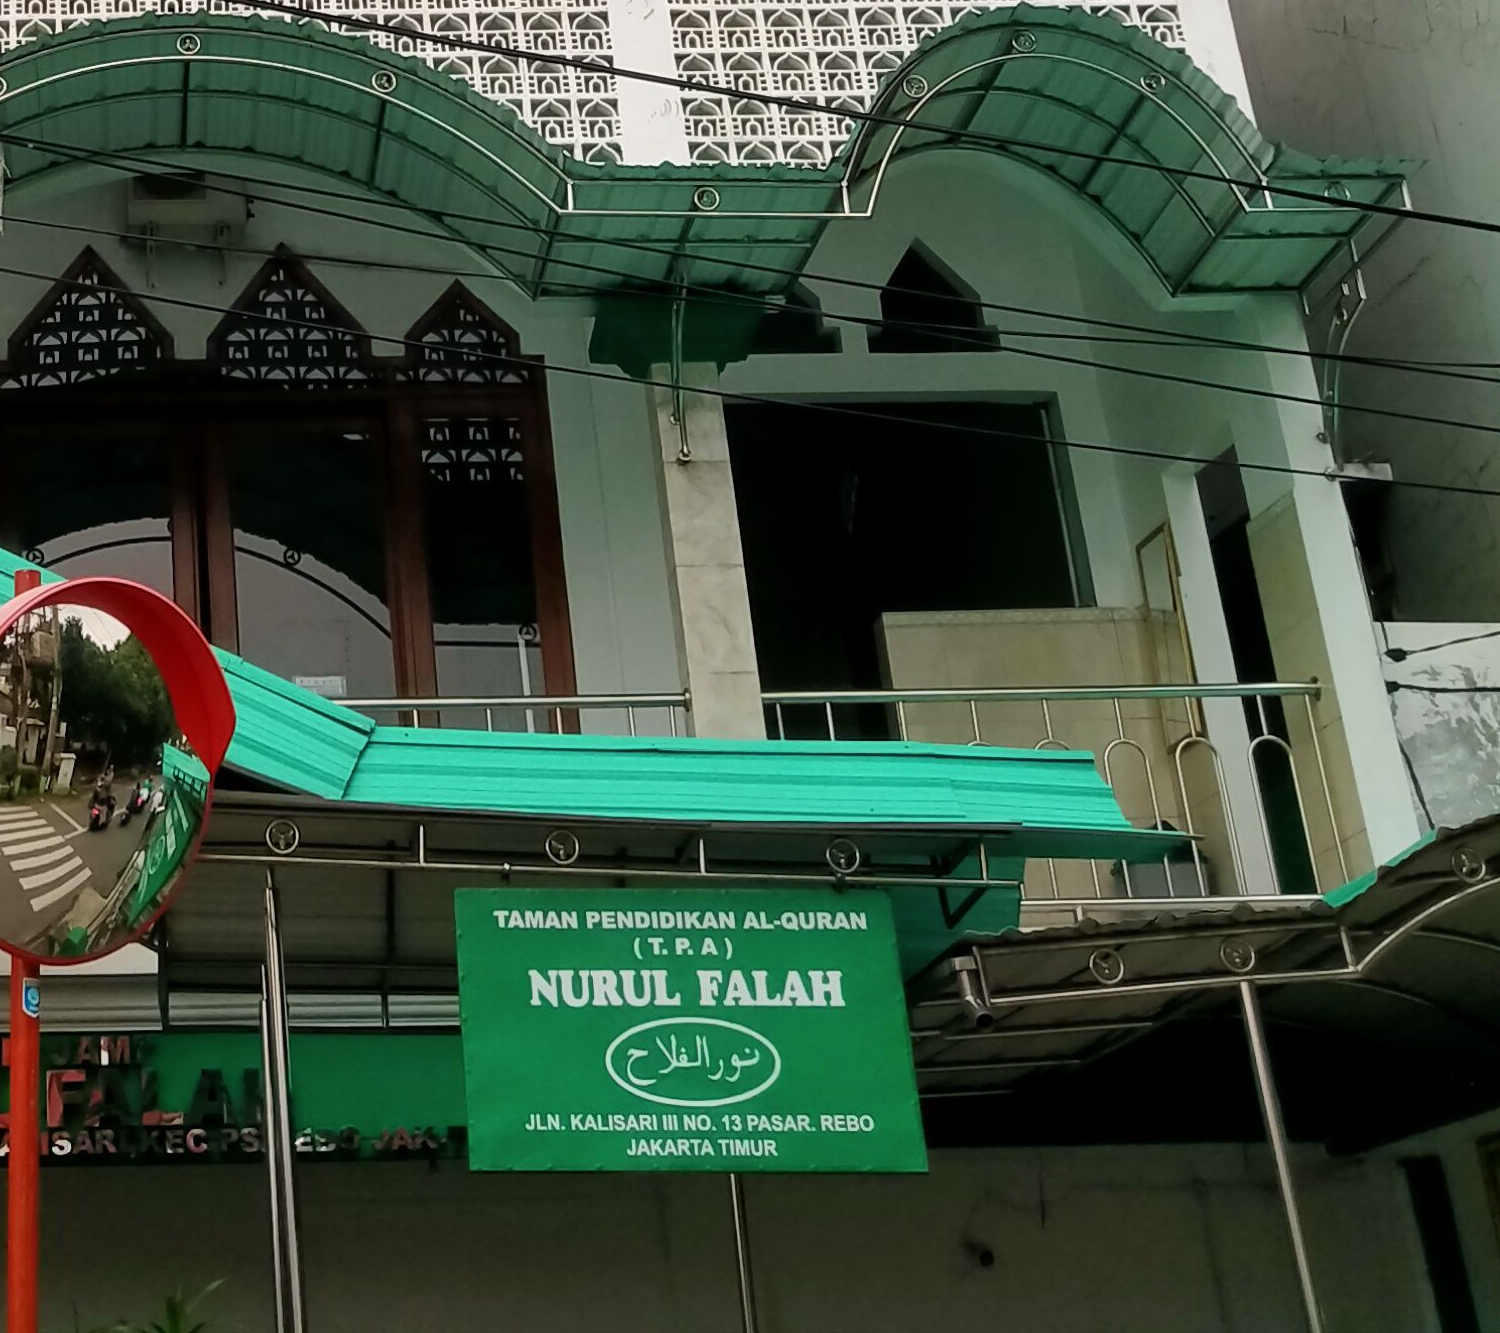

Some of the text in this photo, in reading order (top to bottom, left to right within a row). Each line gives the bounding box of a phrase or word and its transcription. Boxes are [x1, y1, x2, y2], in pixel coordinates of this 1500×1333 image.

[493, 910, 868, 931] TAMAN PENDIDIKAN AL-QURAN
[528, 969, 846, 1008] NURUL FALAH
[525, 1114, 875, 1132] JLN. KALISARI III NO. 13 PASAR. REBO
[626, 1139, 778, 1157] JAKARTA TIMUR
